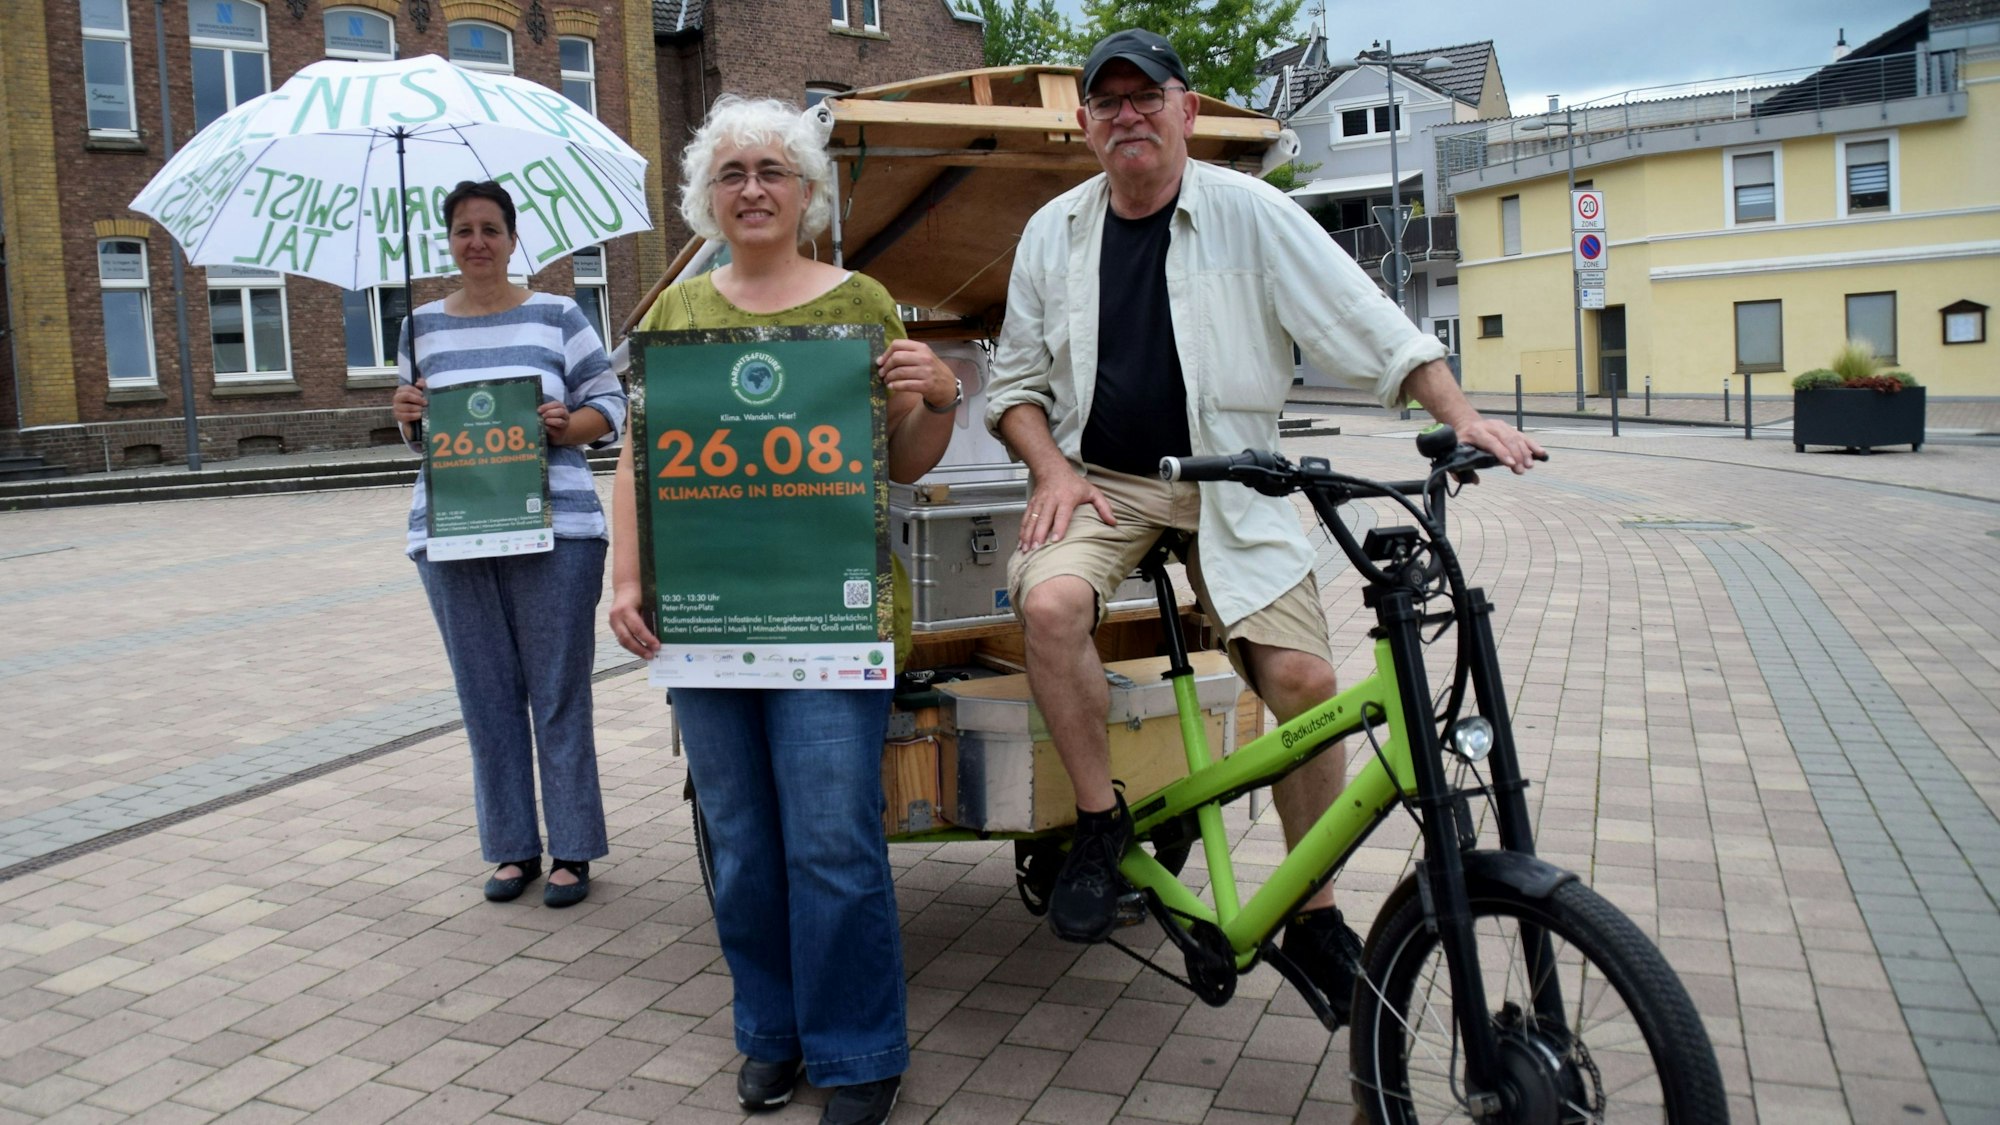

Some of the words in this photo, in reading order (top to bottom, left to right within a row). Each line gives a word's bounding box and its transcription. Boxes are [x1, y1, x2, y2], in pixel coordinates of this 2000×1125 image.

[455, 67, 622, 152] FOR
[1583, 200, 1595, 213] 20
[1581, 220, 1598, 228] ZONE
[720, 413, 742, 422] Klima.
[744, 412, 777, 422] Wandeln.
[778, 412, 797, 421] Hier!
[432, 425, 536, 458] 26.08.
[656, 424, 864, 479] 26.08.
[432, 458, 477, 469] KLIMATAG
[490, 453, 538, 465] BORNHEIM
[658, 484, 742, 501] KLIMATAG
[748, 484, 767, 498] IN
[772, 481, 866, 498] BORNHEIM
[662, 594, 682, 602] 10:30
[687, 594, 707, 602] 13:30
[707, 593, 720, 602] Uhr
[663, 616, 723, 625] Podiumsdiskussion
[768, 614, 823, 624] Energieberatung
[693, 625, 722, 633] Getränke
[728, 625, 747, 633] Musik
[809, 623, 820, 632] für
[821, 623, 839, 632] Groß
[840, 624, 855, 632] und
[855, 623, 873, 632] Klein
[1281, 711, 1336, 749] Radkutsche
